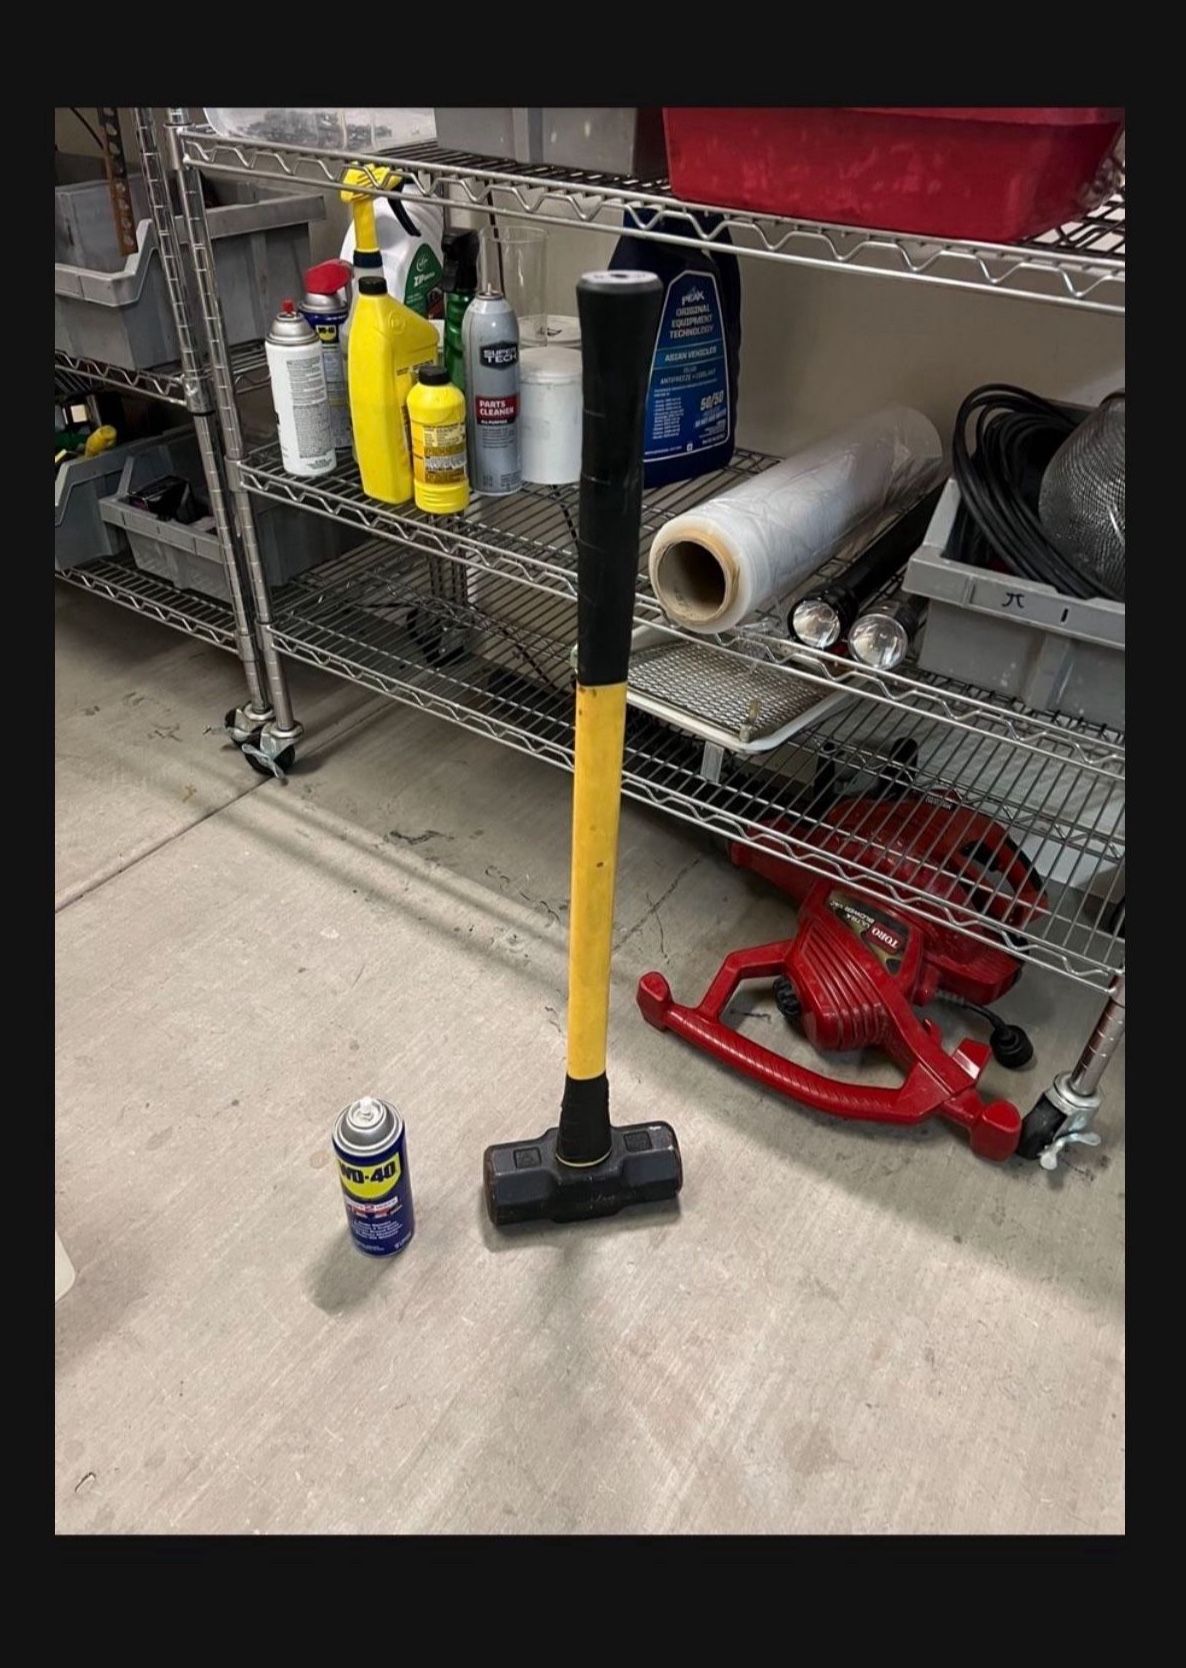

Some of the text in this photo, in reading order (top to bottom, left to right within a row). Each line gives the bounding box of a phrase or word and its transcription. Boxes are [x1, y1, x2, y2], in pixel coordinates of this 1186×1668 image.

[681, 290, 705, 306] PEAK
[675, 304, 710, 317] ORIGINAL
[671, 314, 713, 329] EQUIPMENT
[669, 324, 715, 340] TECHNOLOGY
[487, 353, 518, 364] TECH
[664, 345, 717, 362] ASIAN VEHICLES
[479, 400, 506, 409] PARTS
[700, 389, 725, 412] 50/50
[479, 406, 515, 417] CLEANER
[871, 927, 899, 949] TORO
[339, 1160, 396, 1184] WD-40
